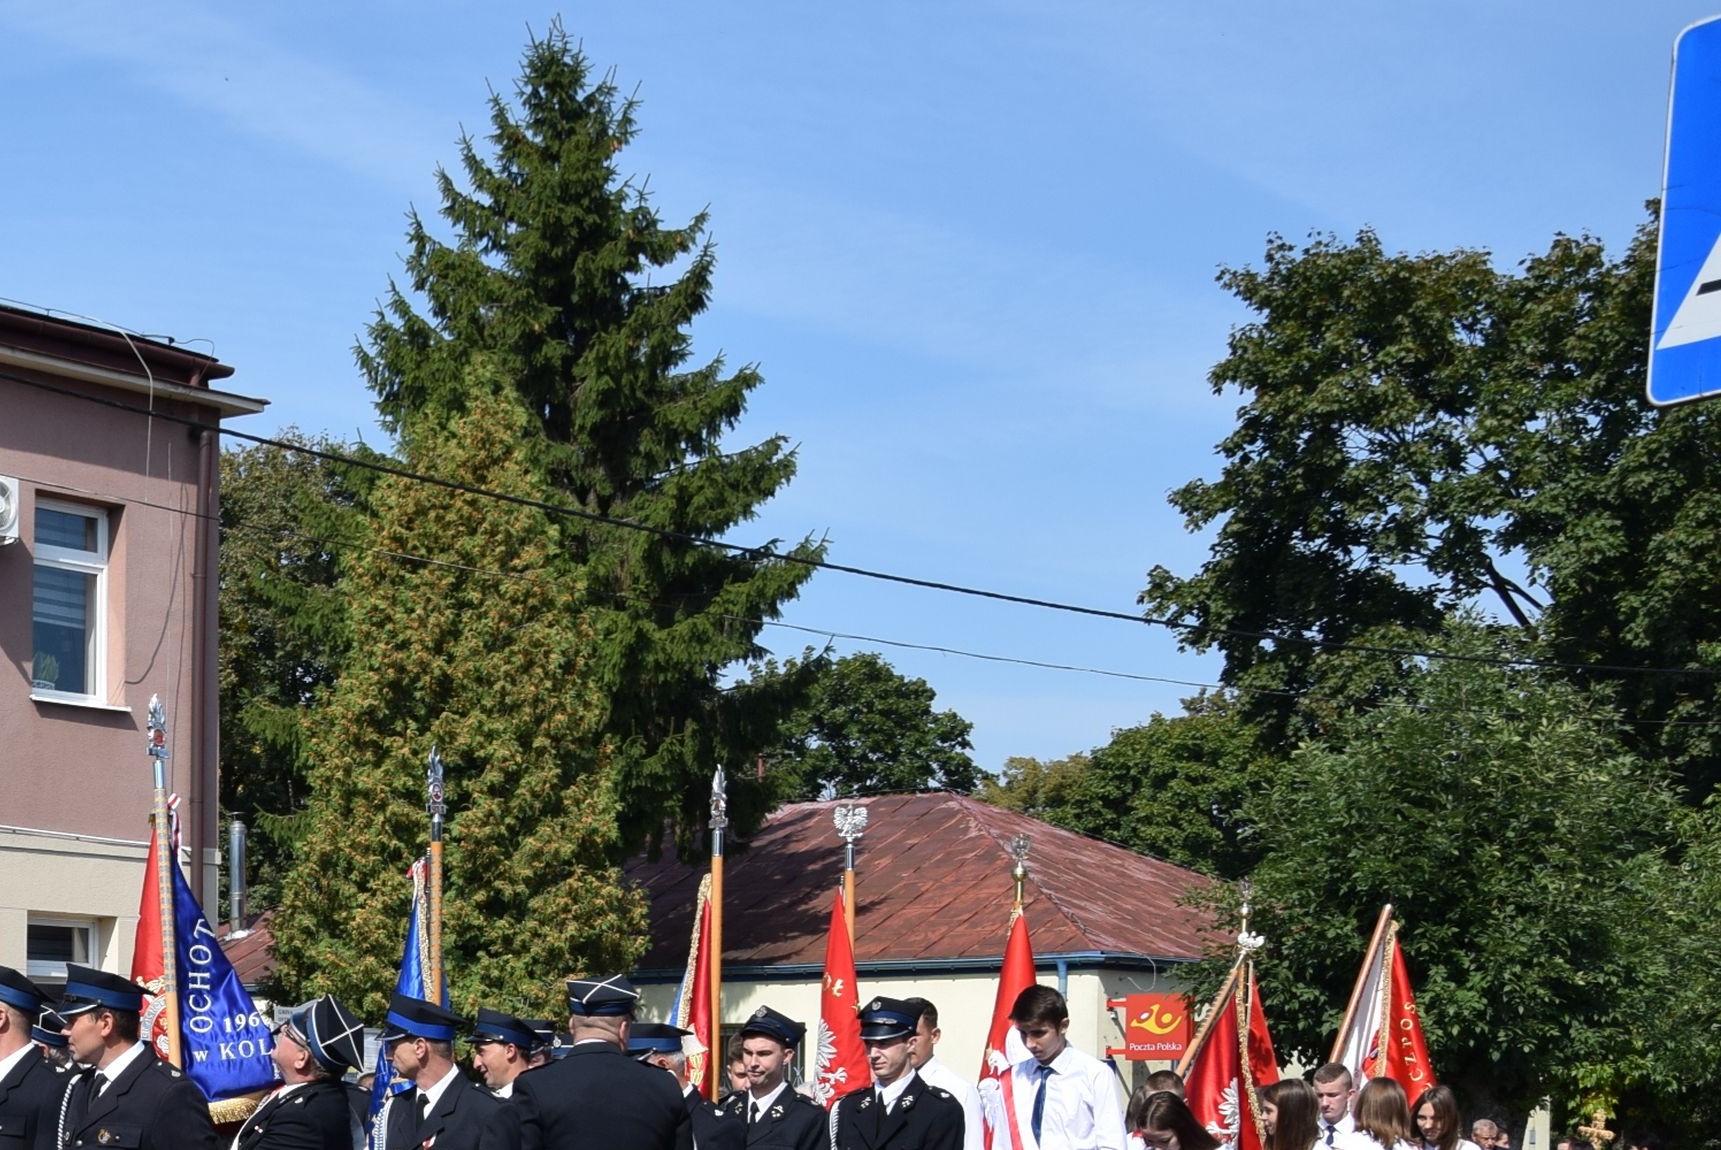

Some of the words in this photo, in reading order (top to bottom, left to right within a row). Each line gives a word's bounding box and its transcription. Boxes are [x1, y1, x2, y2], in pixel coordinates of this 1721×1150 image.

[1129, 1042, 1156, 1051] Poczta
[1157, 1042, 1182, 1051] Polska
[193, 1050, 209, 1062] w
